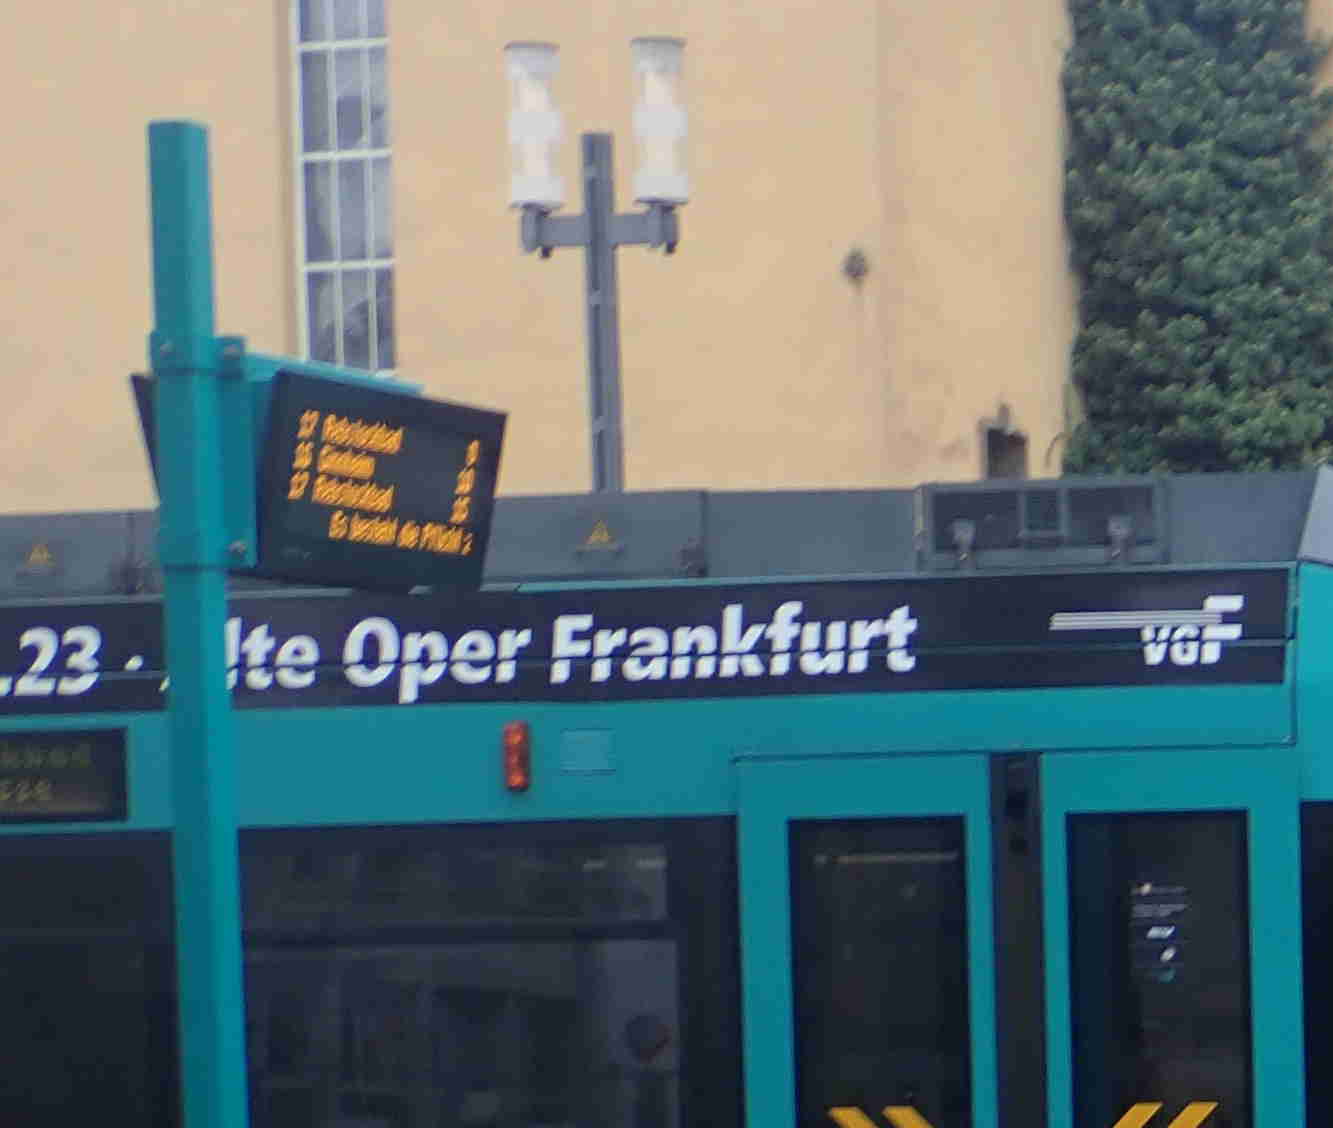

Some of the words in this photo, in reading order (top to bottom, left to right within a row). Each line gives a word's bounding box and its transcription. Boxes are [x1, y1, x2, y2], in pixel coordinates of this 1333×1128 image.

[343, 616, 531, 704] Oper
[550, 600, 918, 684] Frankfurt
[1139, 594, 1244, 666] VGF
